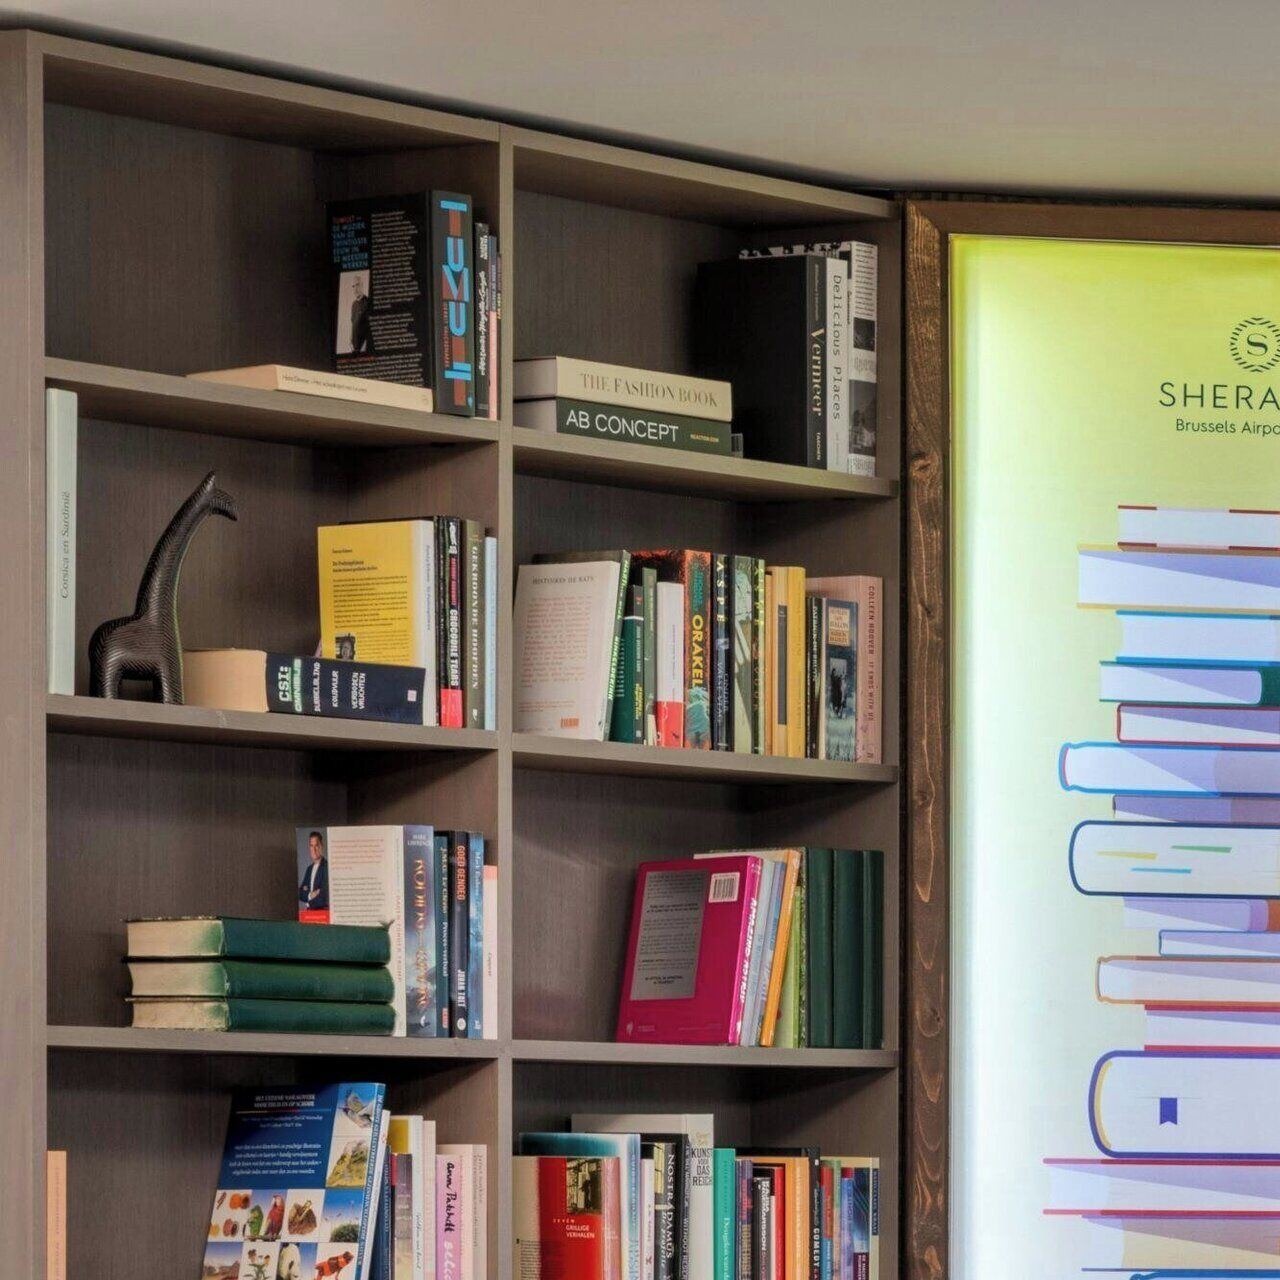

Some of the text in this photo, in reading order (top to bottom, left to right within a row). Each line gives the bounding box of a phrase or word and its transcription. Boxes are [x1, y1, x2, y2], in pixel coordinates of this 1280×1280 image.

[832, 273, 844, 421] Delicious Places
[1246, 333, 1268, 357] S
[580, 371, 719, 409] THE FASHION BOOK
[810, 327, 826, 418] Vermeer
[566, 408, 591, 430] AB
[595, 412, 679, 443] CONCEPT
[1175, 418, 1237, 434] Brussels
[450, 608, 460, 687] CROCODILE TEARS
[691, 614, 704, 688] ORAKEL
[867, 622, 875, 656] HOOVER
[278, 665, 291, 702] CSI:
[293, 658, 303, 712] OMNIBUS
[696, 1165, 711, 1176] DAS
[665, 1152, 675, 1259] NOSTRADAMUS
[565, 1224, 590, 1233] GRILLIGE
[566, 1231, 596, 1240] VERHALEN
